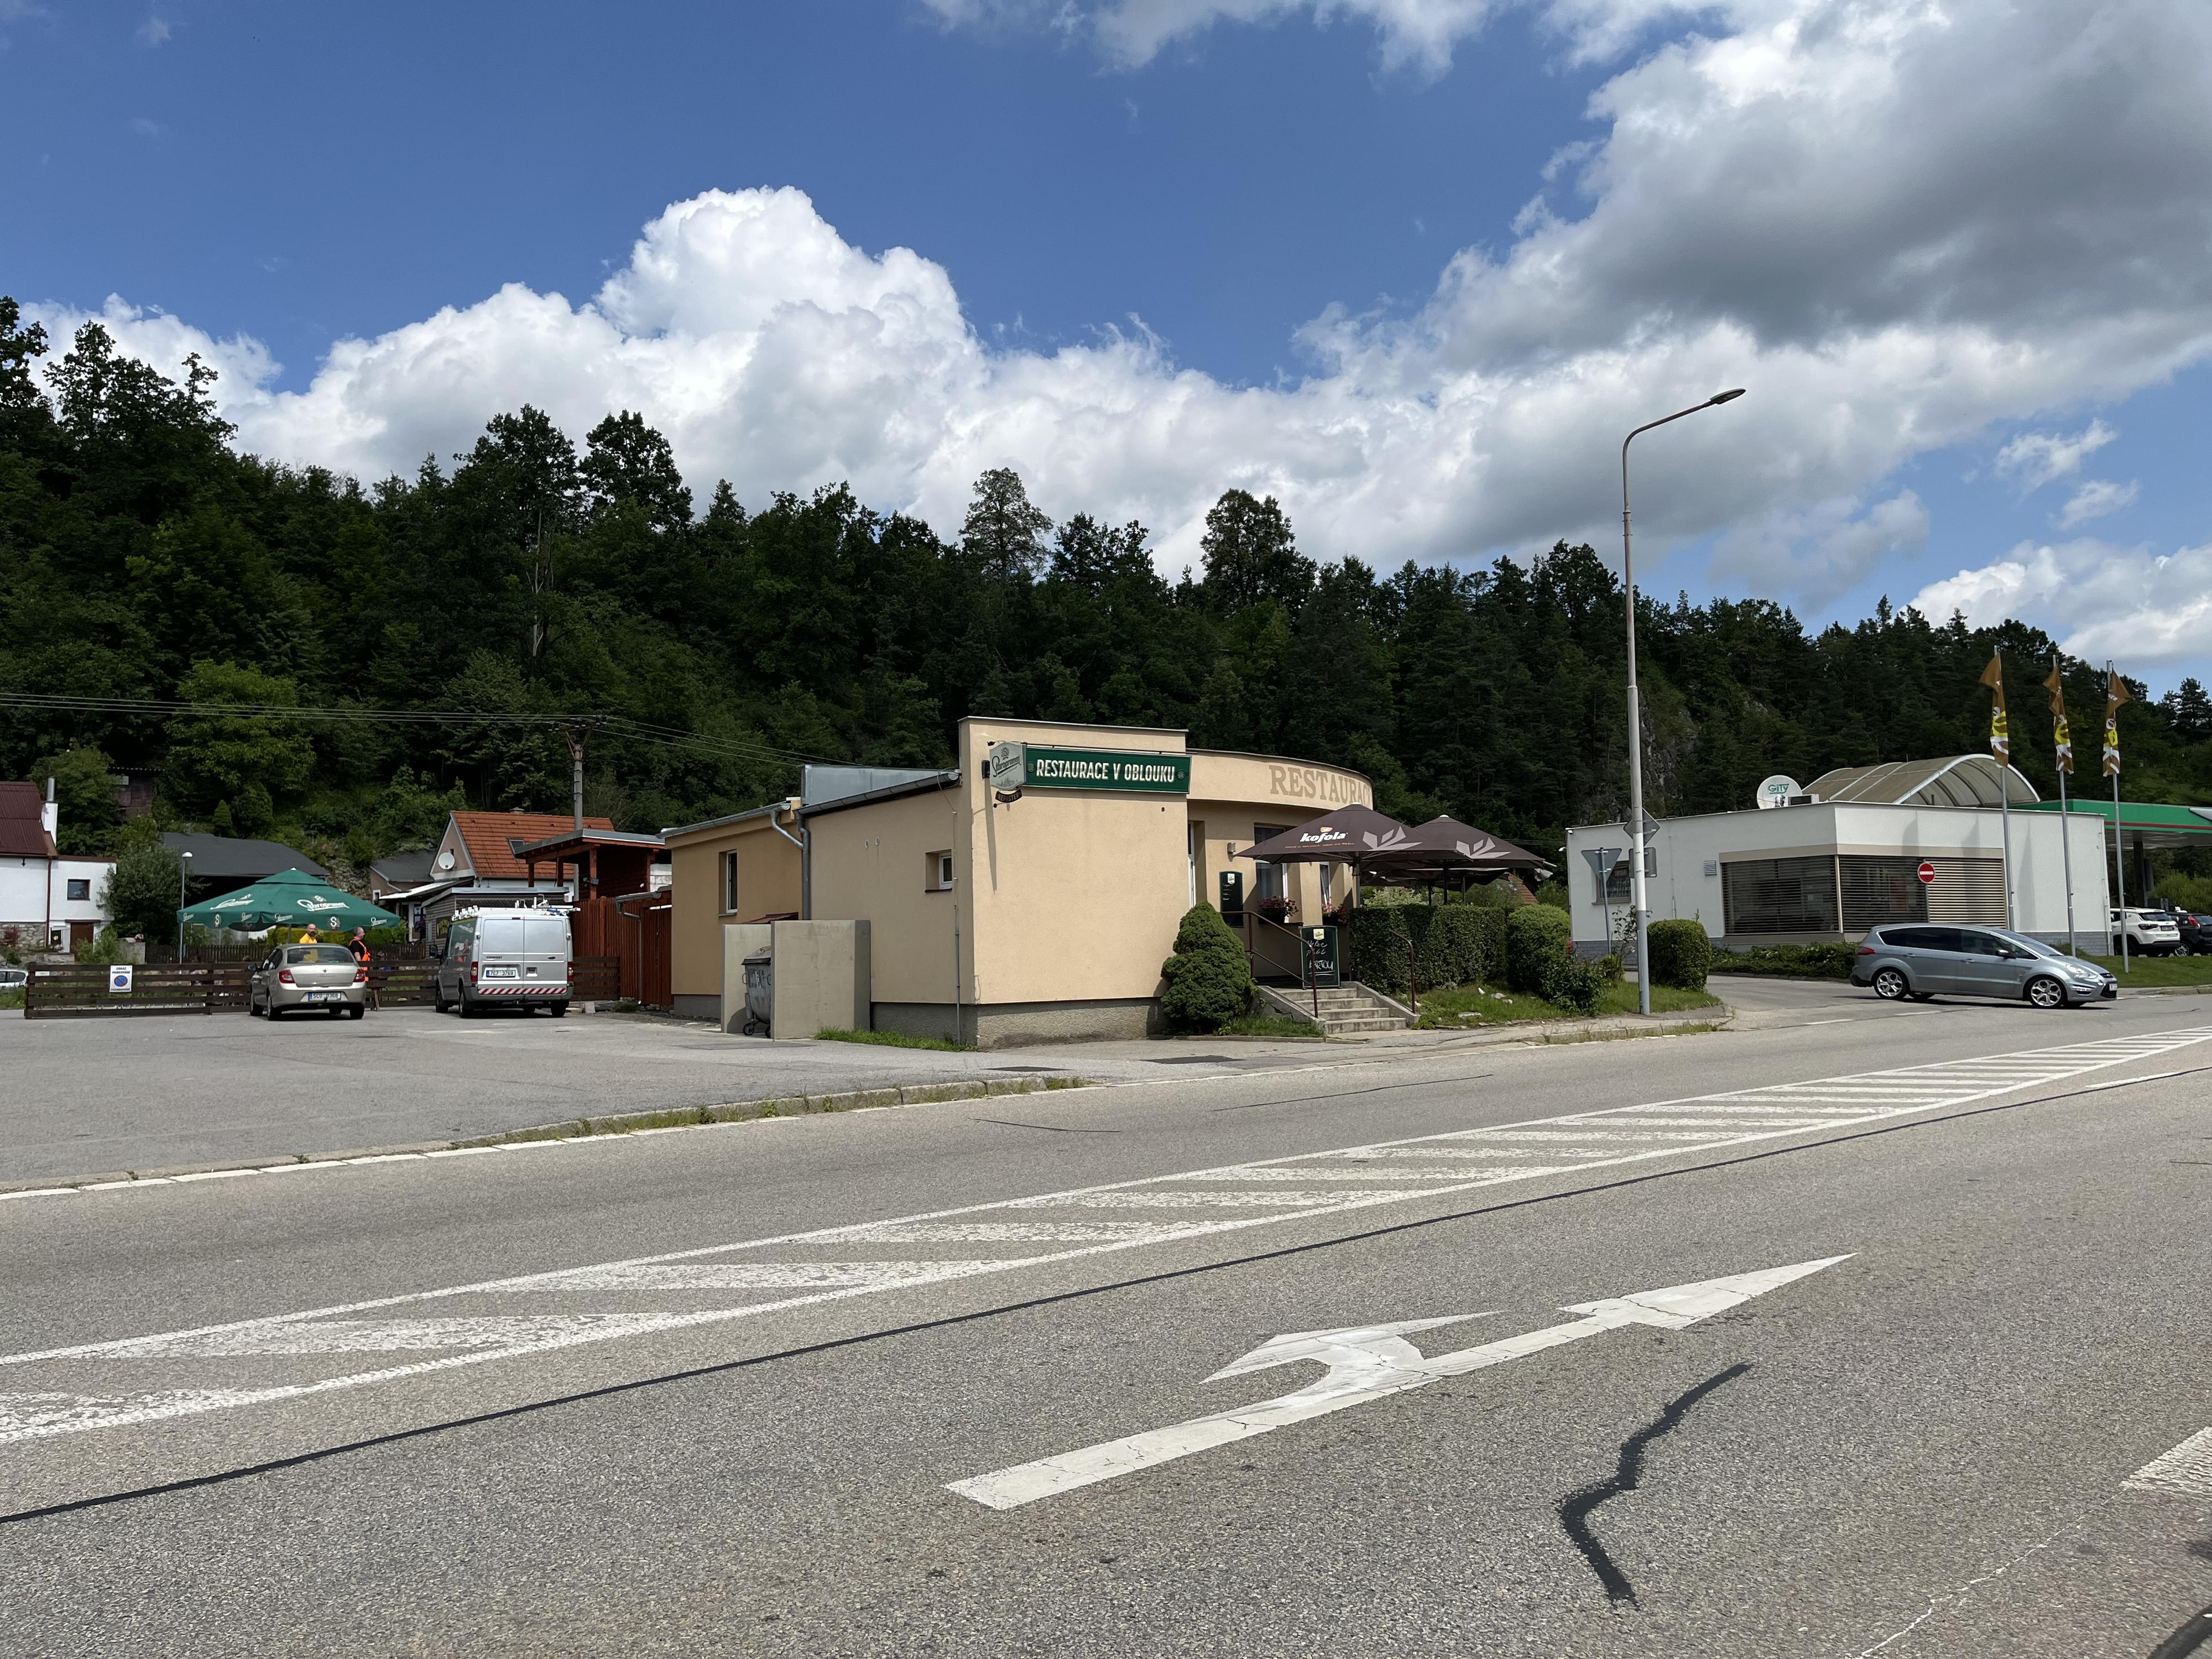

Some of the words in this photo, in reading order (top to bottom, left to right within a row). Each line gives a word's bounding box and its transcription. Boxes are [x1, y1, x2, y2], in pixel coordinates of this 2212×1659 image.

[1036, 759, 1109, 779] RESTAURACE
[1113, 763, 1121, 780] V
[1124, 764, 1175, 782] OBLOUKU
[1300, 831, 1347, 843] kofola
